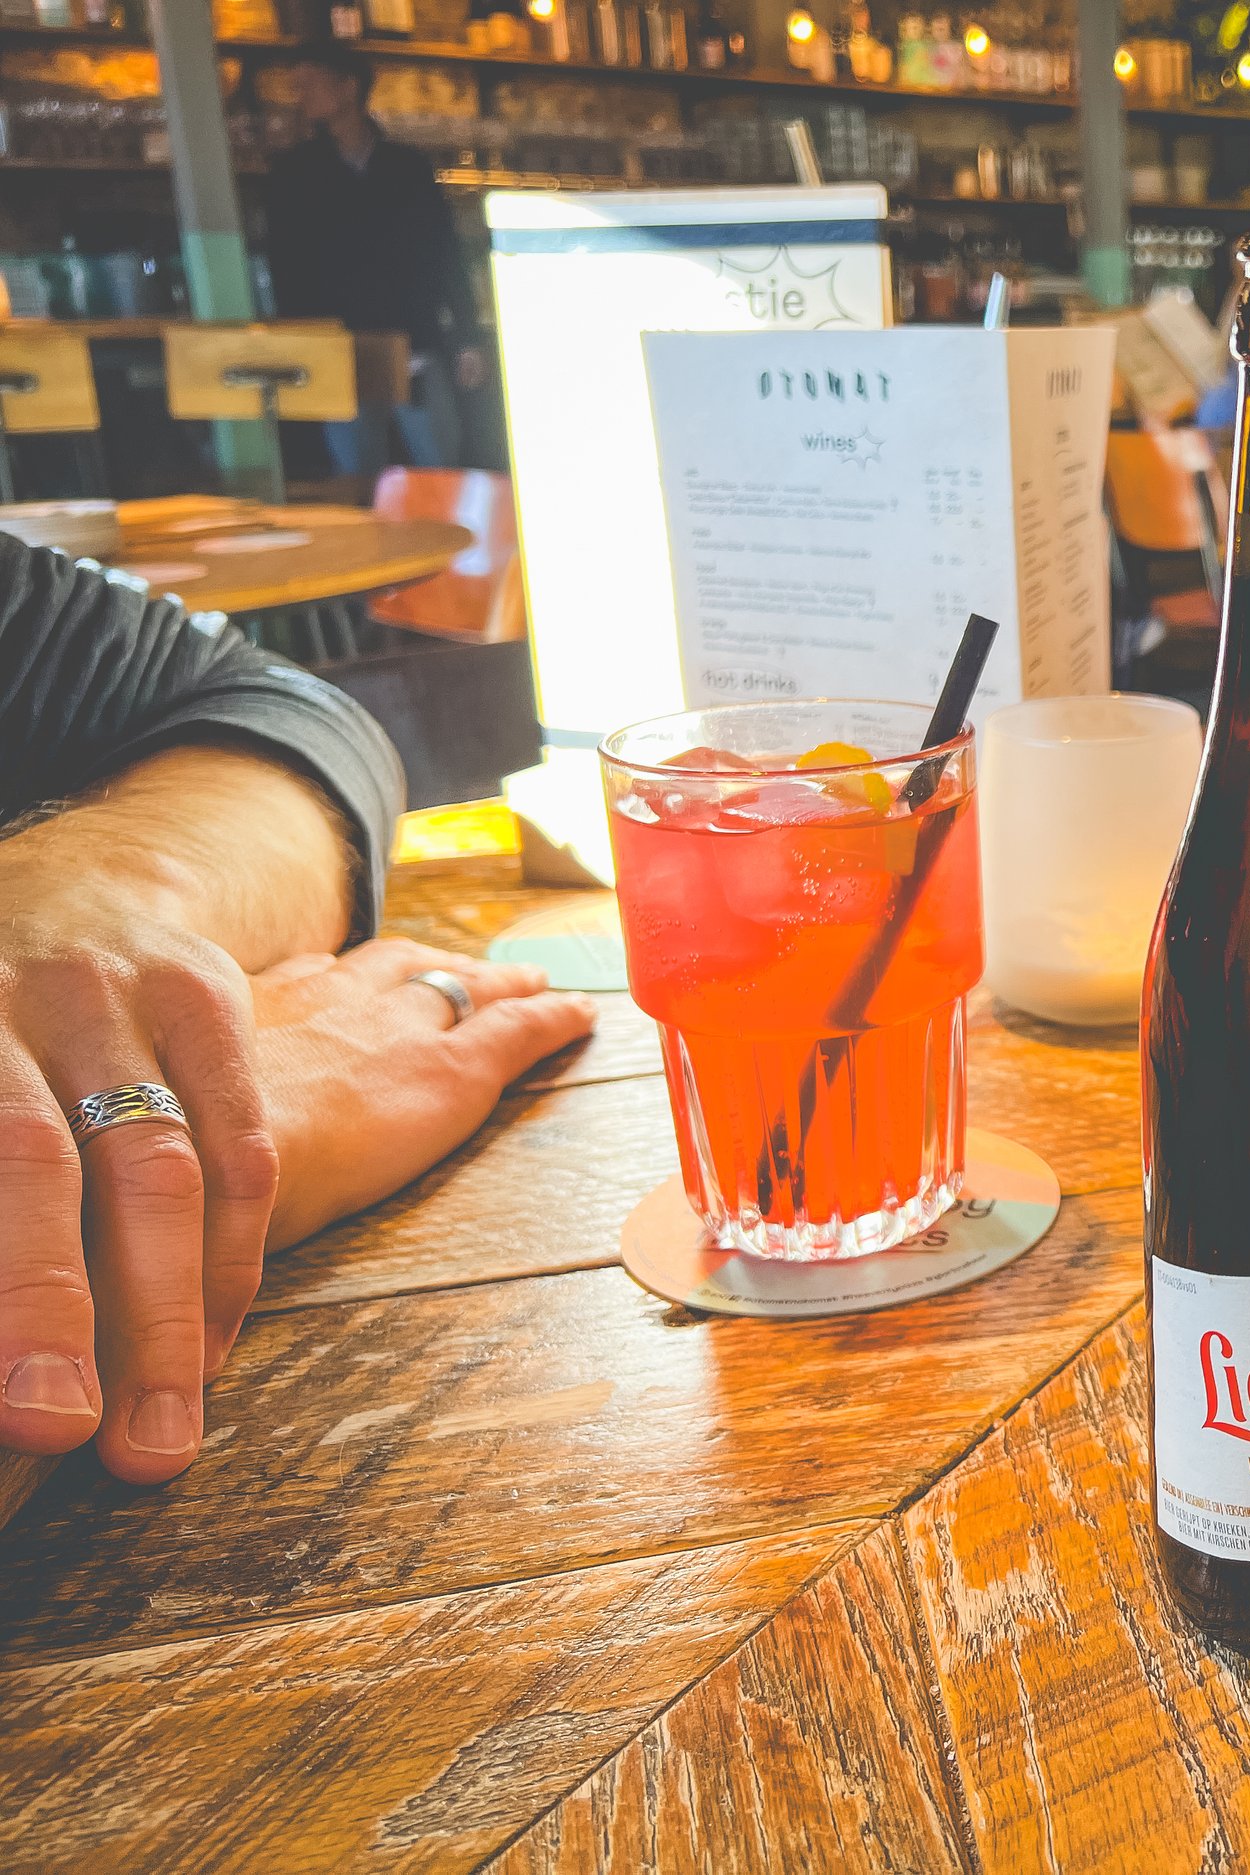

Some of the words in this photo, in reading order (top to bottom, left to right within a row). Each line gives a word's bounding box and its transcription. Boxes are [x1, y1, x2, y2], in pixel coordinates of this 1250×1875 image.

[801, 431, 857, 453] wines
[704, 669, 737, 690] hot
[742, 671, 799, 694] drinks
[1174, 1506, 1200, 1528] GERIJPT
[1202, 1516, 1212, 1531] OP
[1212, 1520, 1250, 1539] KRIEKEN,
[1177, 1520, 1193, 1537] BIER
[1193, 1526, 1206, 1542] MIT
[1207, 1530, 1247, 1551] KIRSCHEN
